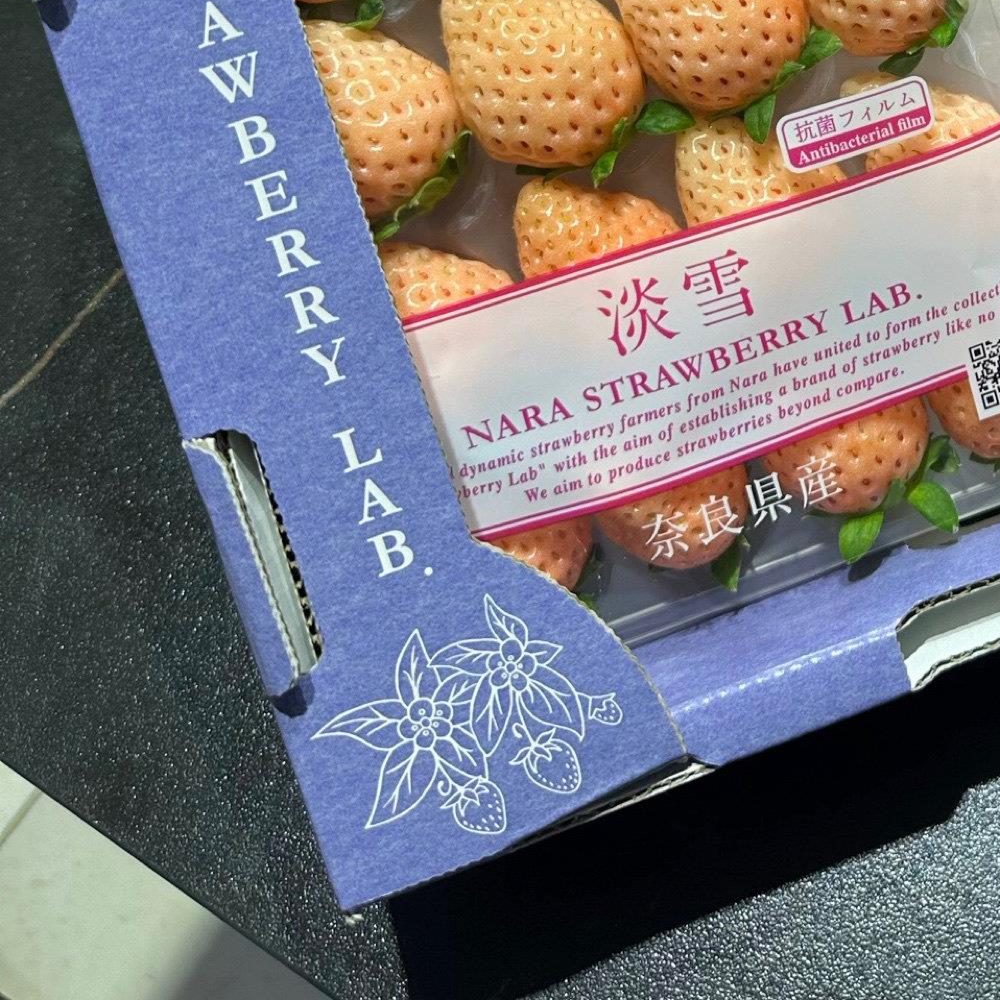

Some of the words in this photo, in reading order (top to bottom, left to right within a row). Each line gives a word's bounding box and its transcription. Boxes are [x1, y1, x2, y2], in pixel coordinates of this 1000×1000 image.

[794, 92, 915, 143] 抗菌フィルム
[798, 123, 895, 165] Antibacterial
[897, 114, 926, 132] film
[460, 397, 574, 449] NARA
[583, 309, 828, 412] STRAWBERRY
[839, 282, 923, 326] LAB.
[596, 248, 755, 357] 淡雪
[458, 480, 502, 504] berry
[508, 463, 545, 486] Lab"
[553, 452, 588, 472] with
[593, 445, 617, 461] the
[624, 435, 652, 451] aim
[658, 423, 673, 442] of
[680, 391, 773, 433] establishing
[779, 386, 788, 396] a
[792, 364, 836, 391] brand
[842, 356, 857, 374] of
[863, 330, 940, 366] strawberry
[946, 318, 971, 336] like
[978, 311, 995, 324] no
[460, 449, 524, 478] dynamic
[531, 423, 614, 458] strawberry
[620, 402, 681, 434] farmers
[687, 387, 725, 413] from
[729, 371, 768, 393] Nara
[773, 356, 807, 376] have
[814, 333, 861, 362] united
[866, 330, 880, 343] to
[885, 316, 922, 340] form
[926, 306, 947, 321] the
[524, 487, 547, 502] We
[554, 480, 583, 495] aim
[588, 473, 601, 486] to
[608, 451, 670, 483] produce
[677, 414, 772, 457] strawberries
[778, 388, 831, 419] beyond
[837, 367, 904, 397] compare.
[332, 427, 434, 578] LAB.
[641, 452, 845, 562] 奈良県産
